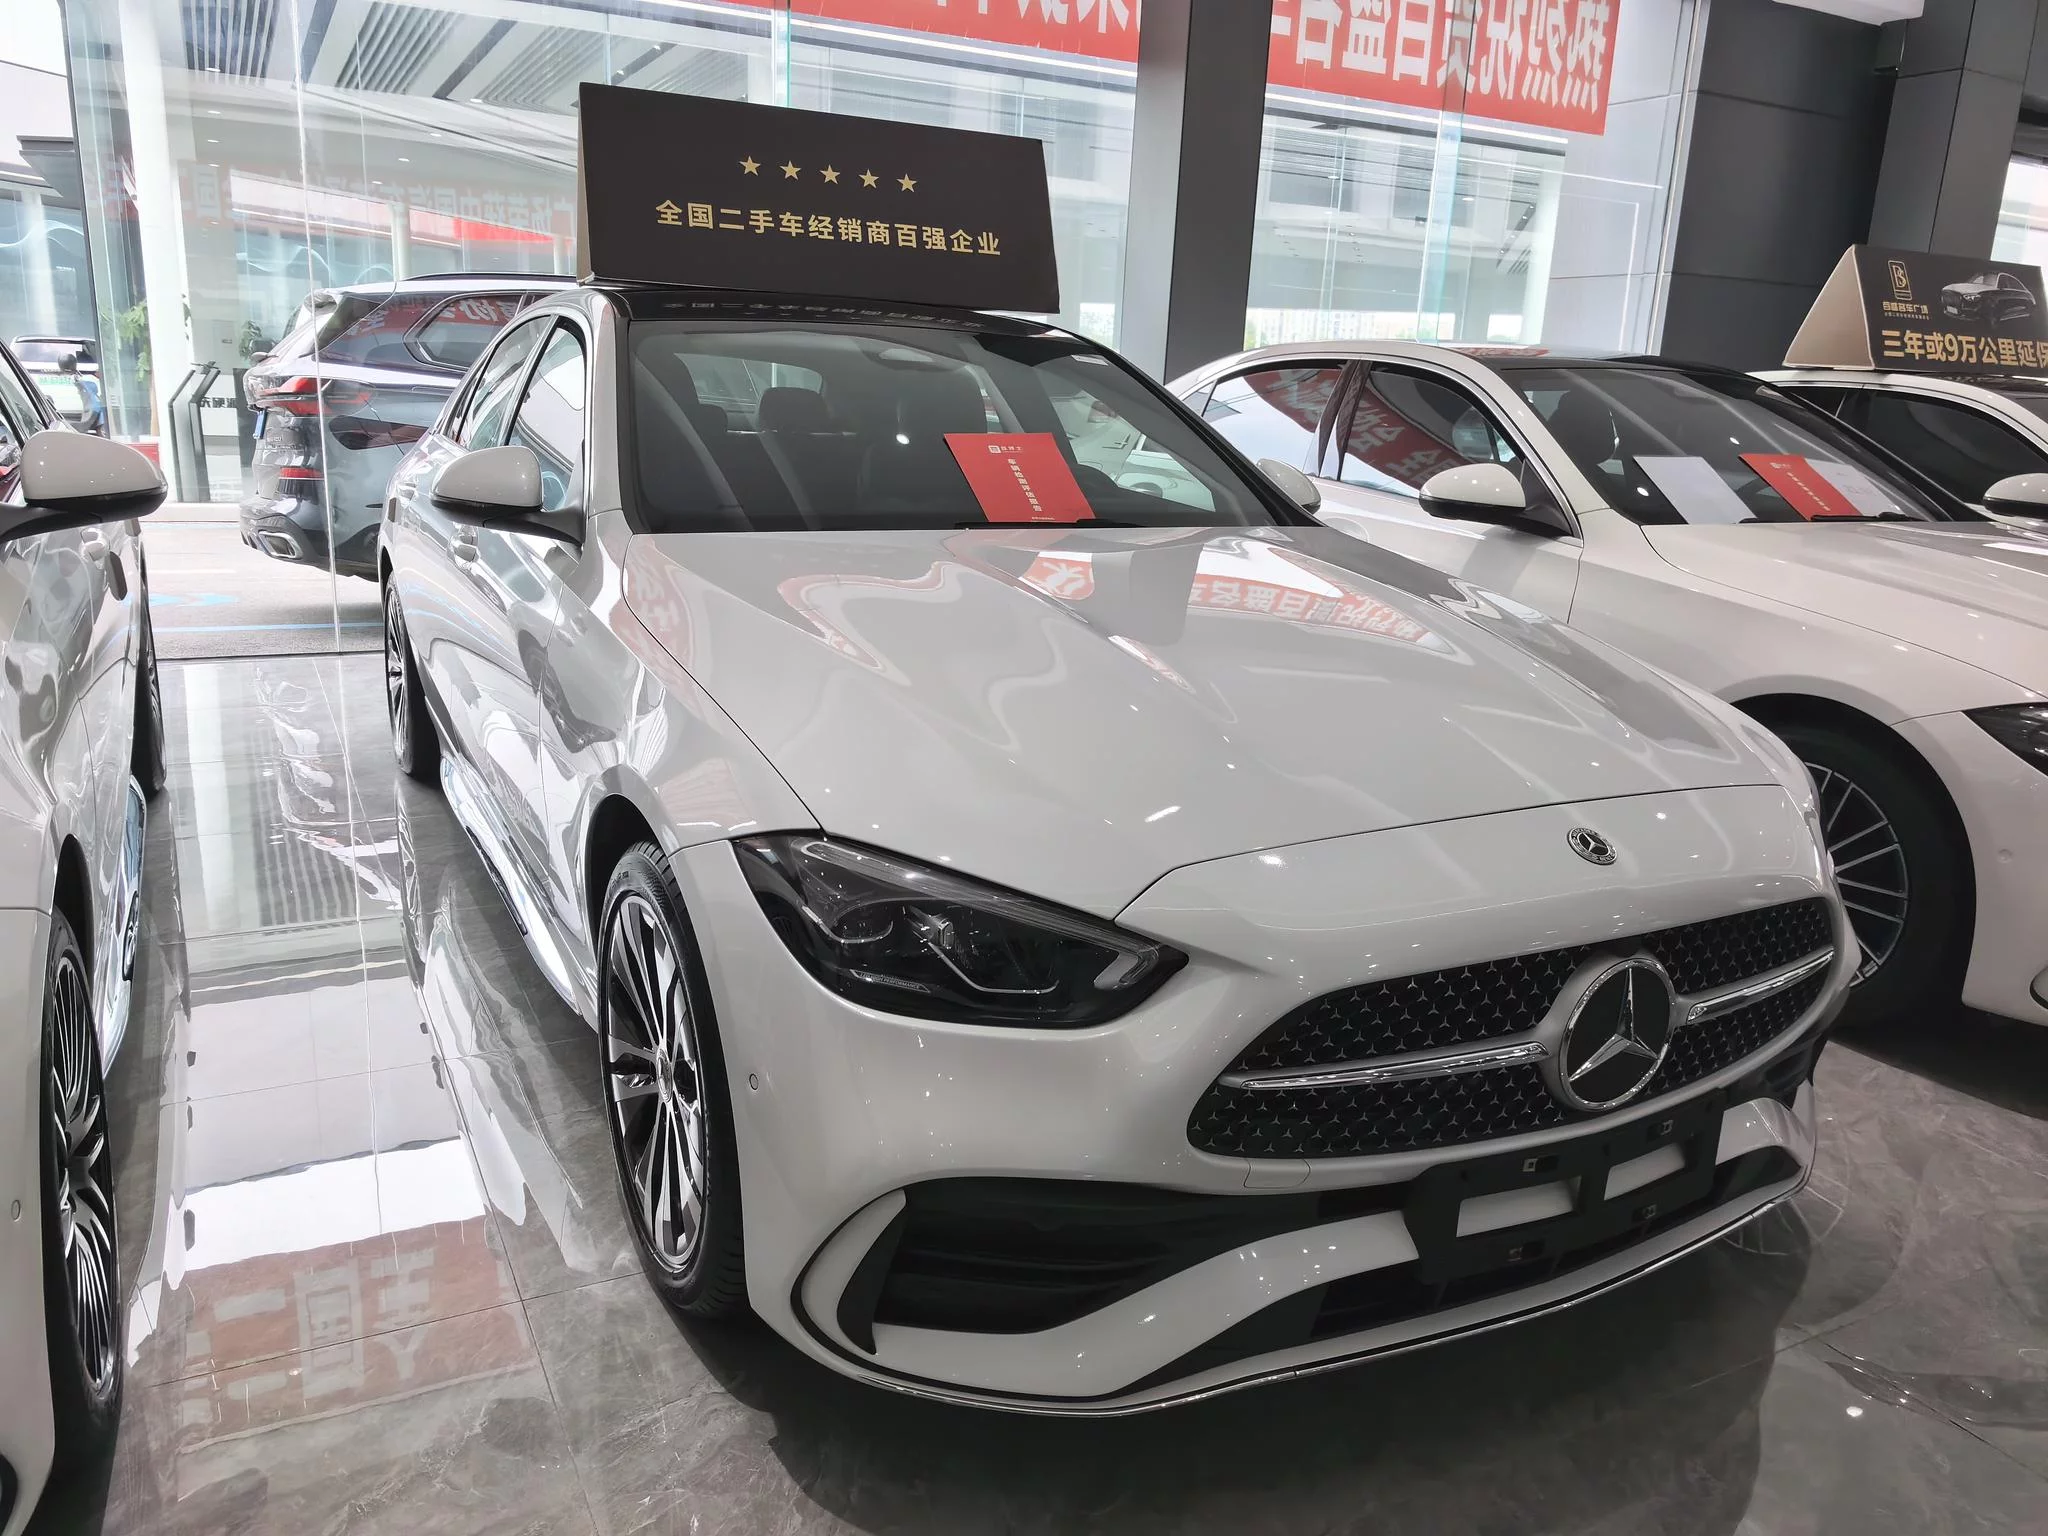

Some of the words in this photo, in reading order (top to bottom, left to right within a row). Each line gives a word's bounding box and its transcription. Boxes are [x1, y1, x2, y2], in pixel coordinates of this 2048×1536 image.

[655, 199, 1001, 257] 全国二手车经销商百强企业
[1881, 329, 2048, 369] 三年或9万公里延保
